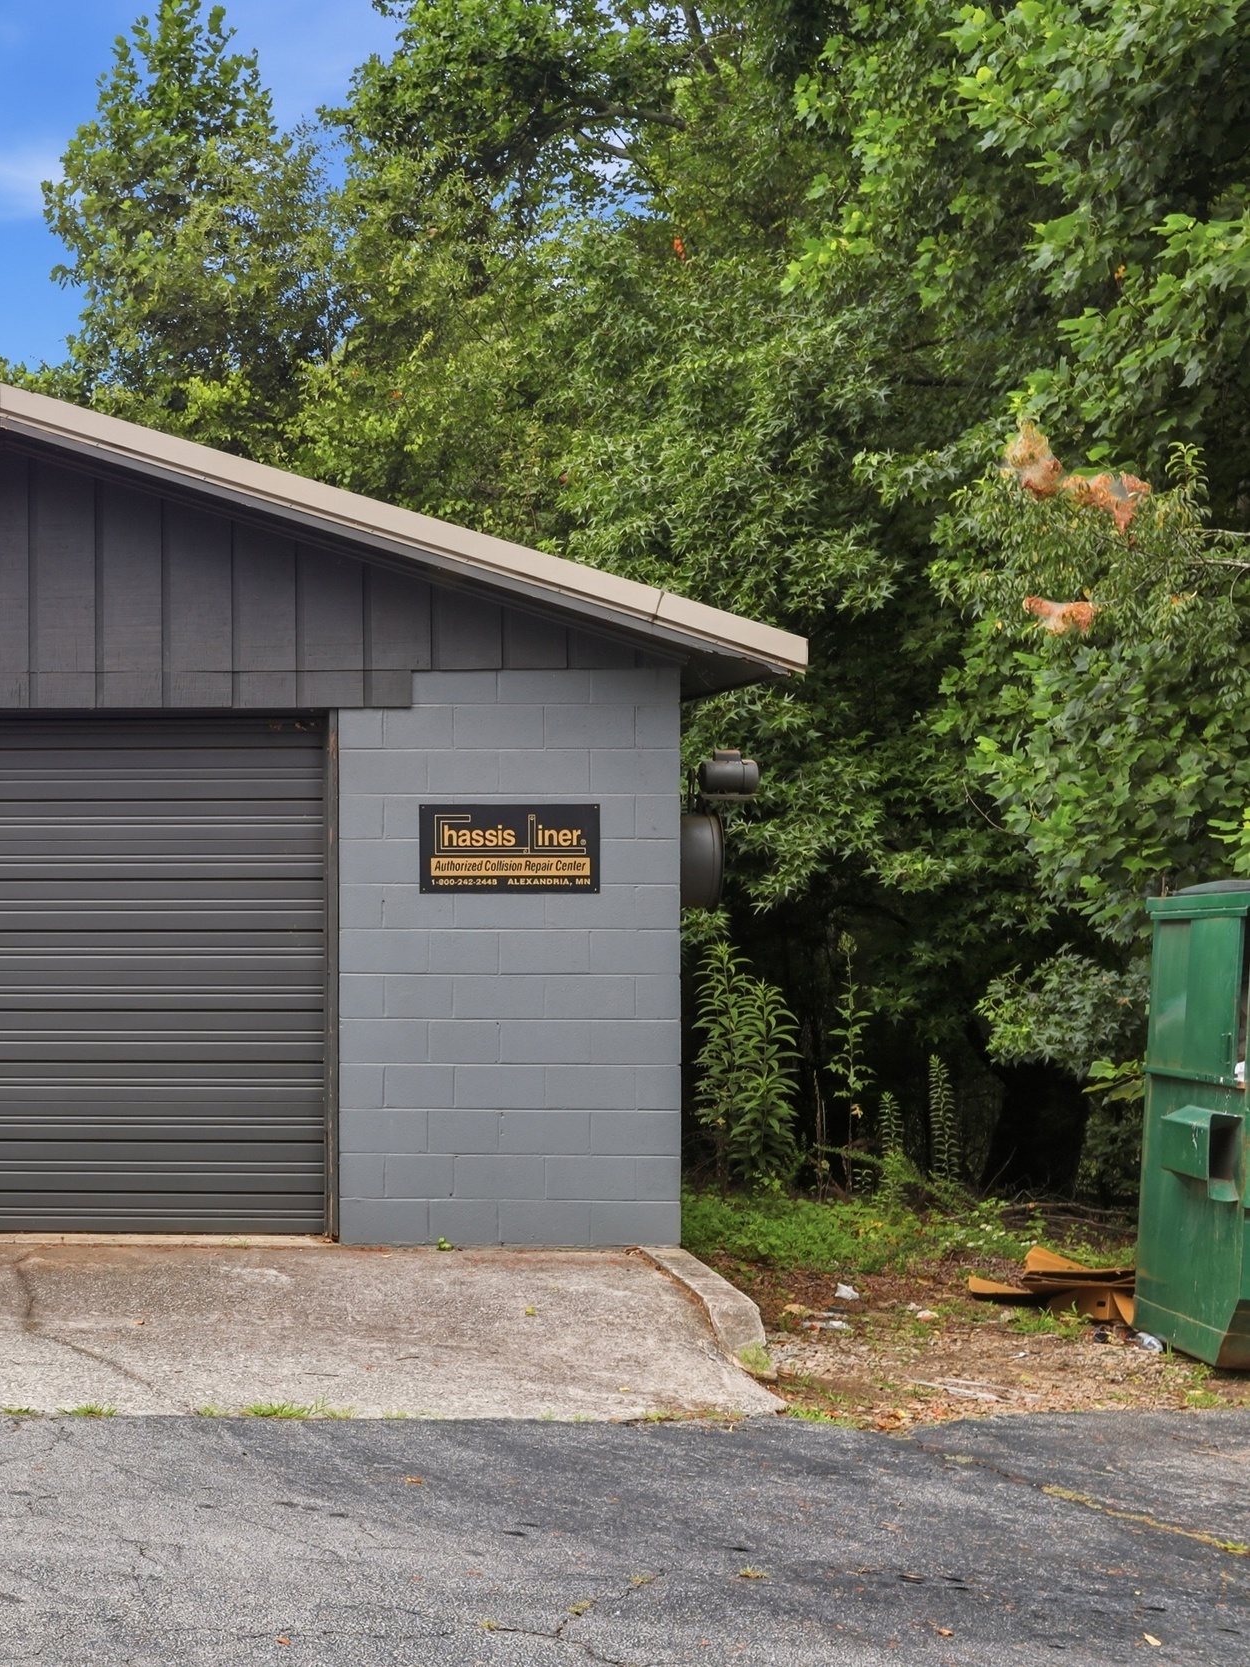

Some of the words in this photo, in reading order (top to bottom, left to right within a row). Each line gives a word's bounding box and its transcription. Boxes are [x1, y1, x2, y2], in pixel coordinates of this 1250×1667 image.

[435, 859, 483, 872] Authorized
[484, 859, 523, 872] Collision
[524, 859, 554, 874] Repair
[555, 859, 586, 872] Center
[507, 877, 573, 886] ALEXANDRIA,
[577, 877, 591, 886] MN
